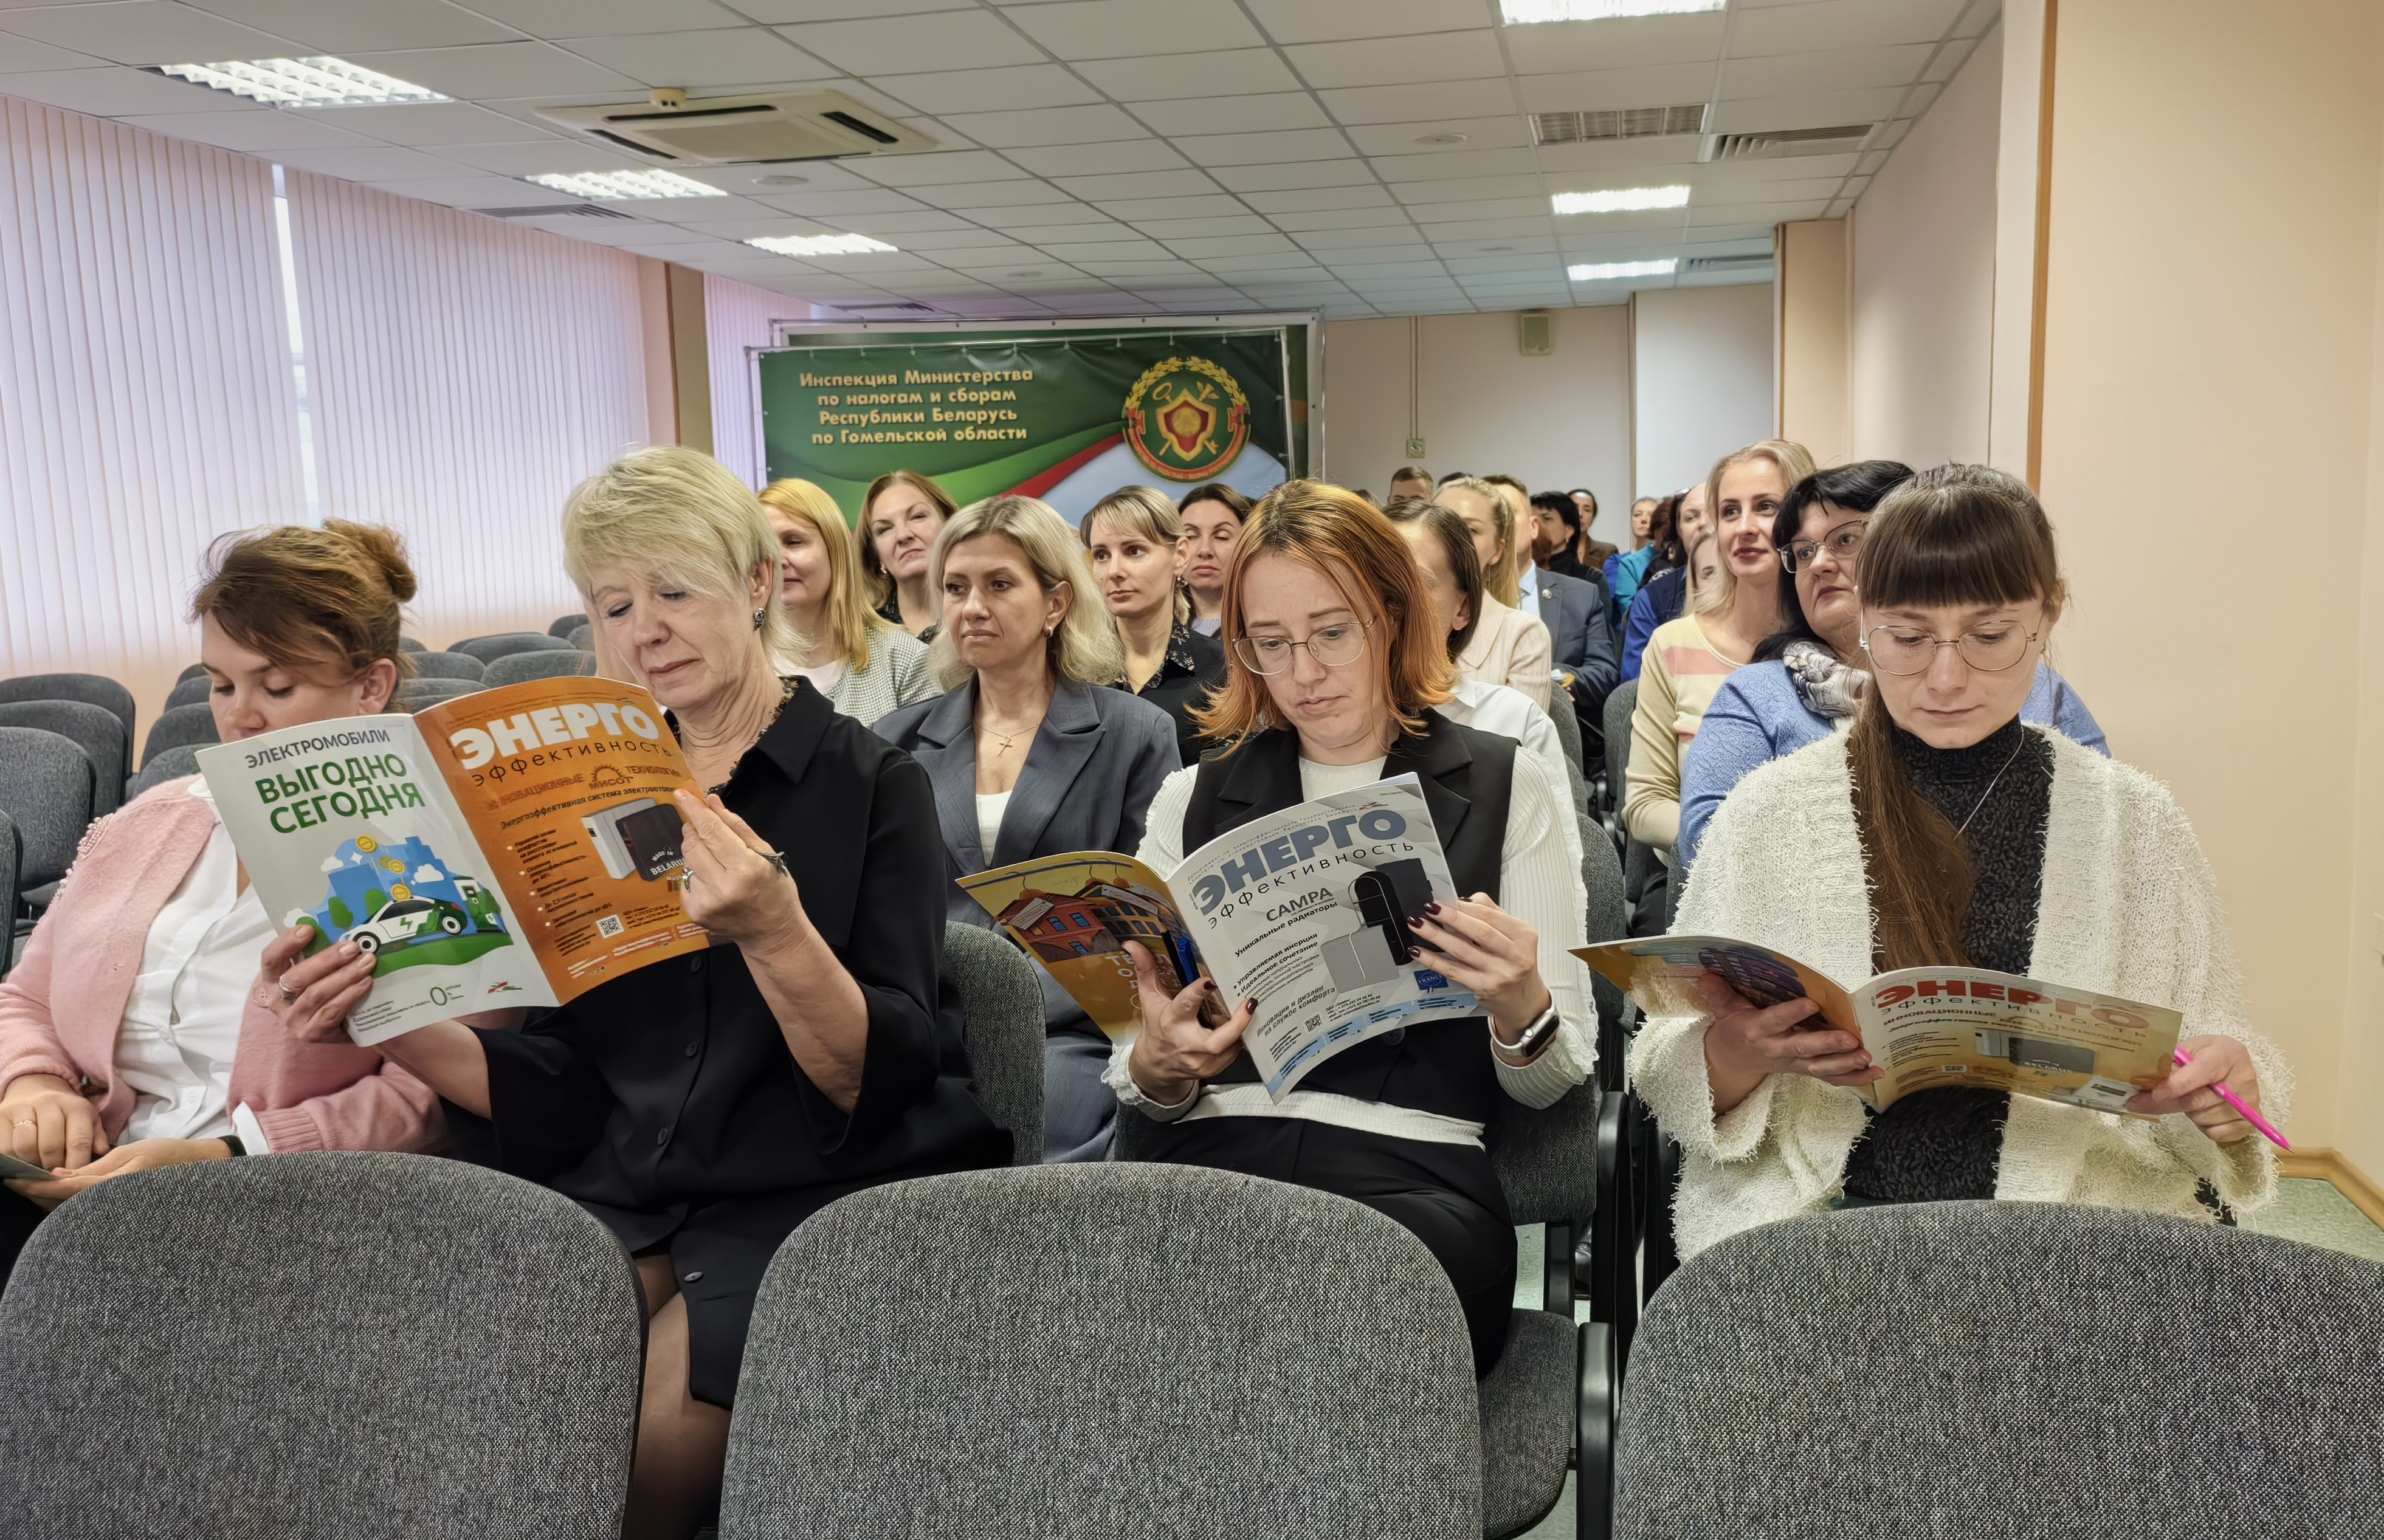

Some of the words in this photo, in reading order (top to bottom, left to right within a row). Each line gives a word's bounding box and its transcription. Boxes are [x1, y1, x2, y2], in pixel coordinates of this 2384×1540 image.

[800, 373, 898, 388] Инспекция
[904, 369, 1033, 385] Министерства
[818, 395, 839, 406] по
[847, 393, 923, 405] налогам
[930, 393, 942, 403] и
[948, 387, 1017, 405] сборам
[812, 432, 834, 444] по
[841, 428, 947, 444] Гомельской
[954, 426, 1027, 441] области
[819, 408, 925, 427] Республики
[932, 408, 1018, 424] Беларусь
[245, 729, 391, 769] ЭЛЕКТРОМОБИЛИ
[449, 703, 660, 770] ЭНЕРГО
[255, 754, 407, 804] ВЫГОДНО
[587, 789, 621, 802] система
[270, 782, 426, 834] СЕГОДНЯ
[1192, 810, 1406, 916] ЭНЕРГО
[1235, 923, 1286, 957] Уникальные
[1287, 902, 1338, 926] радиаторы
[1237, 950, 1283, 986] Управляемая
[1284, 933, 1318, 953] инерция
[1241, 962, 1278, 993] Идеальное
[1279, 941, 1318, 964] сочетание
[1256, 1005, 1289, 1037] Инновации
[1297, 985, 1323, 1005] дизайн
[1273, 1008, 1297, 1028] службе
[1298, 987, 1335, 1010] комфорта
[1876, 980, 2149, 1028] ЭНЕРГО
[1884, 1009, 1997, 1026] ИННОВАЦИОННЫЕ
